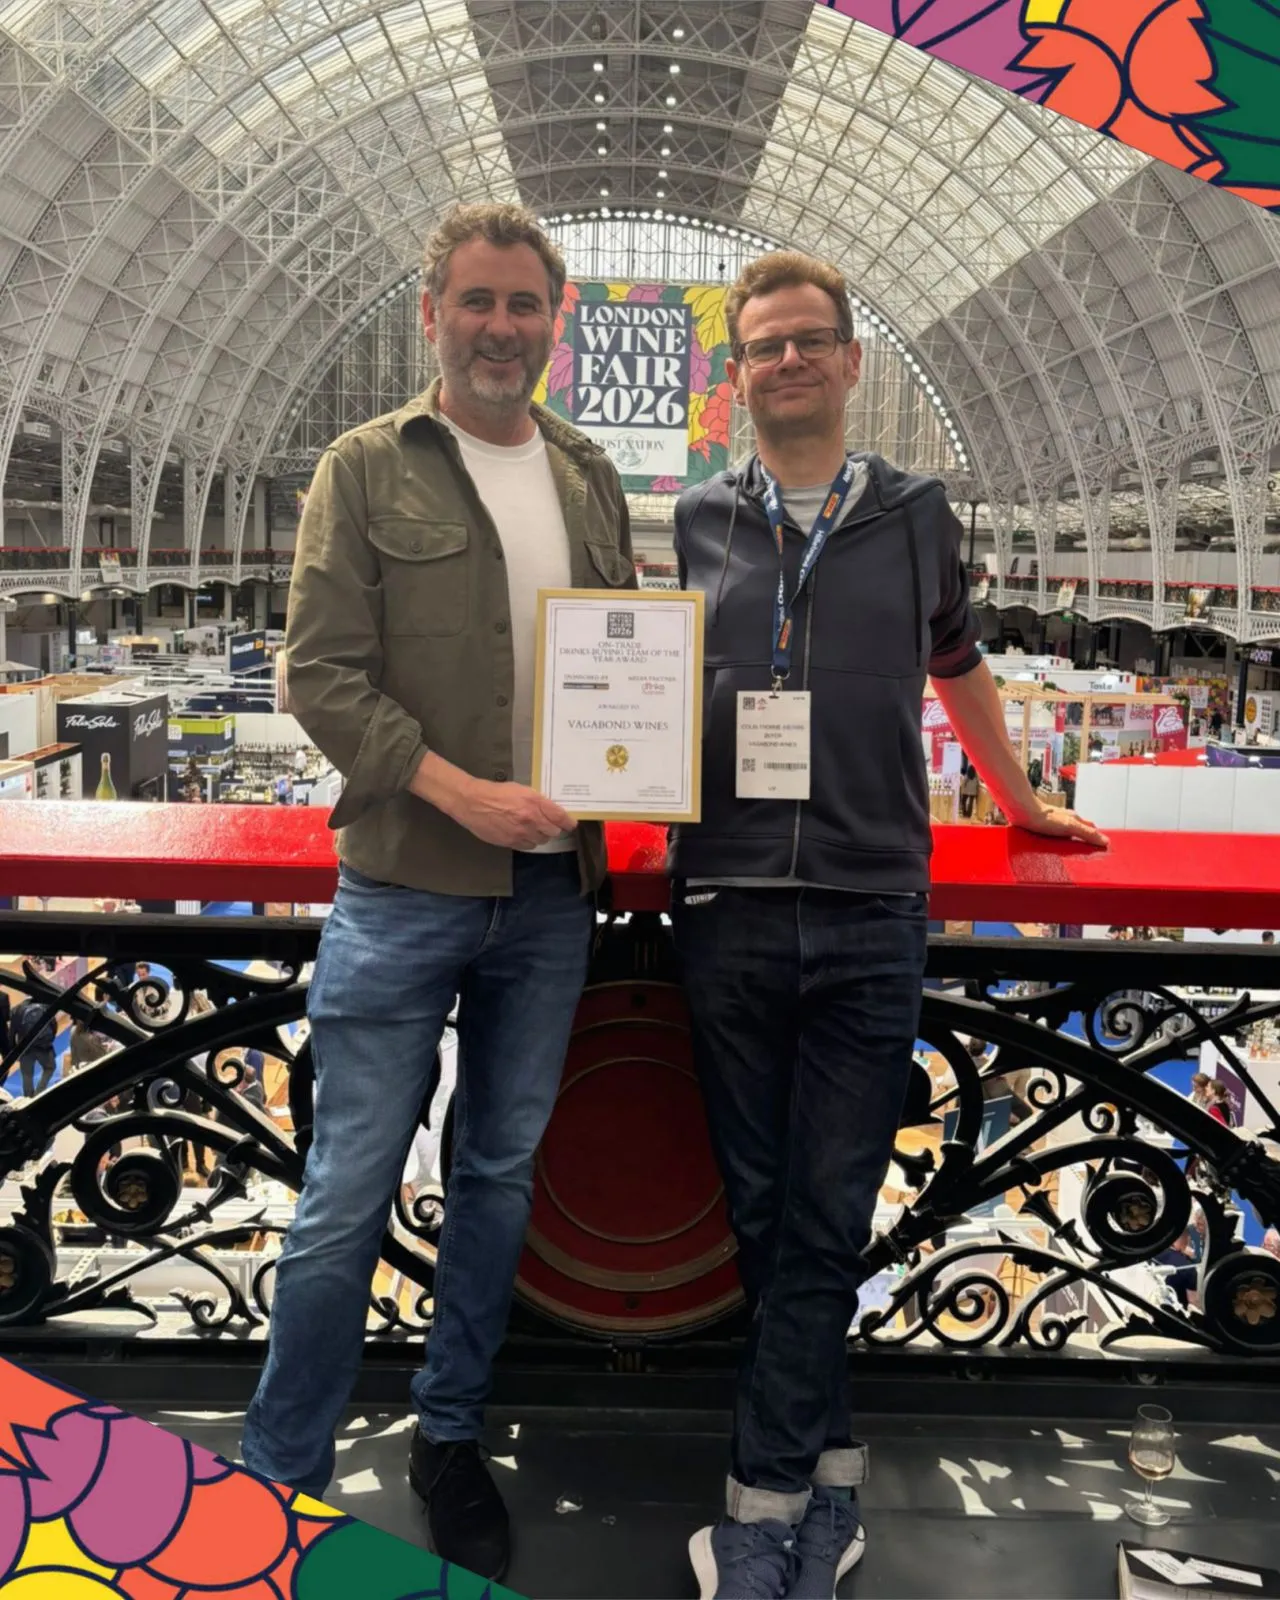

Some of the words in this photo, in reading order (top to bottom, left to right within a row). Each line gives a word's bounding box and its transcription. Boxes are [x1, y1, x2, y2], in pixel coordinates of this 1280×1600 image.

[581, 305, 686, 326] LONDON
[581, 325, 686, 354] WINE
[579, 354, 682, 387] FAIR
[577, 386, 685, 425] 2026
[625, 438, 665, 451] NATION
[598, 641, 641, 649] ON-TRADE
[592, 655, 613, 663] YEAR
[650, 649, 661, 657] OF
[663, 649, 680, 657] THE
[567, 719, 631, 730] VAGABOND
[633, 720, 669, 731] WINES
